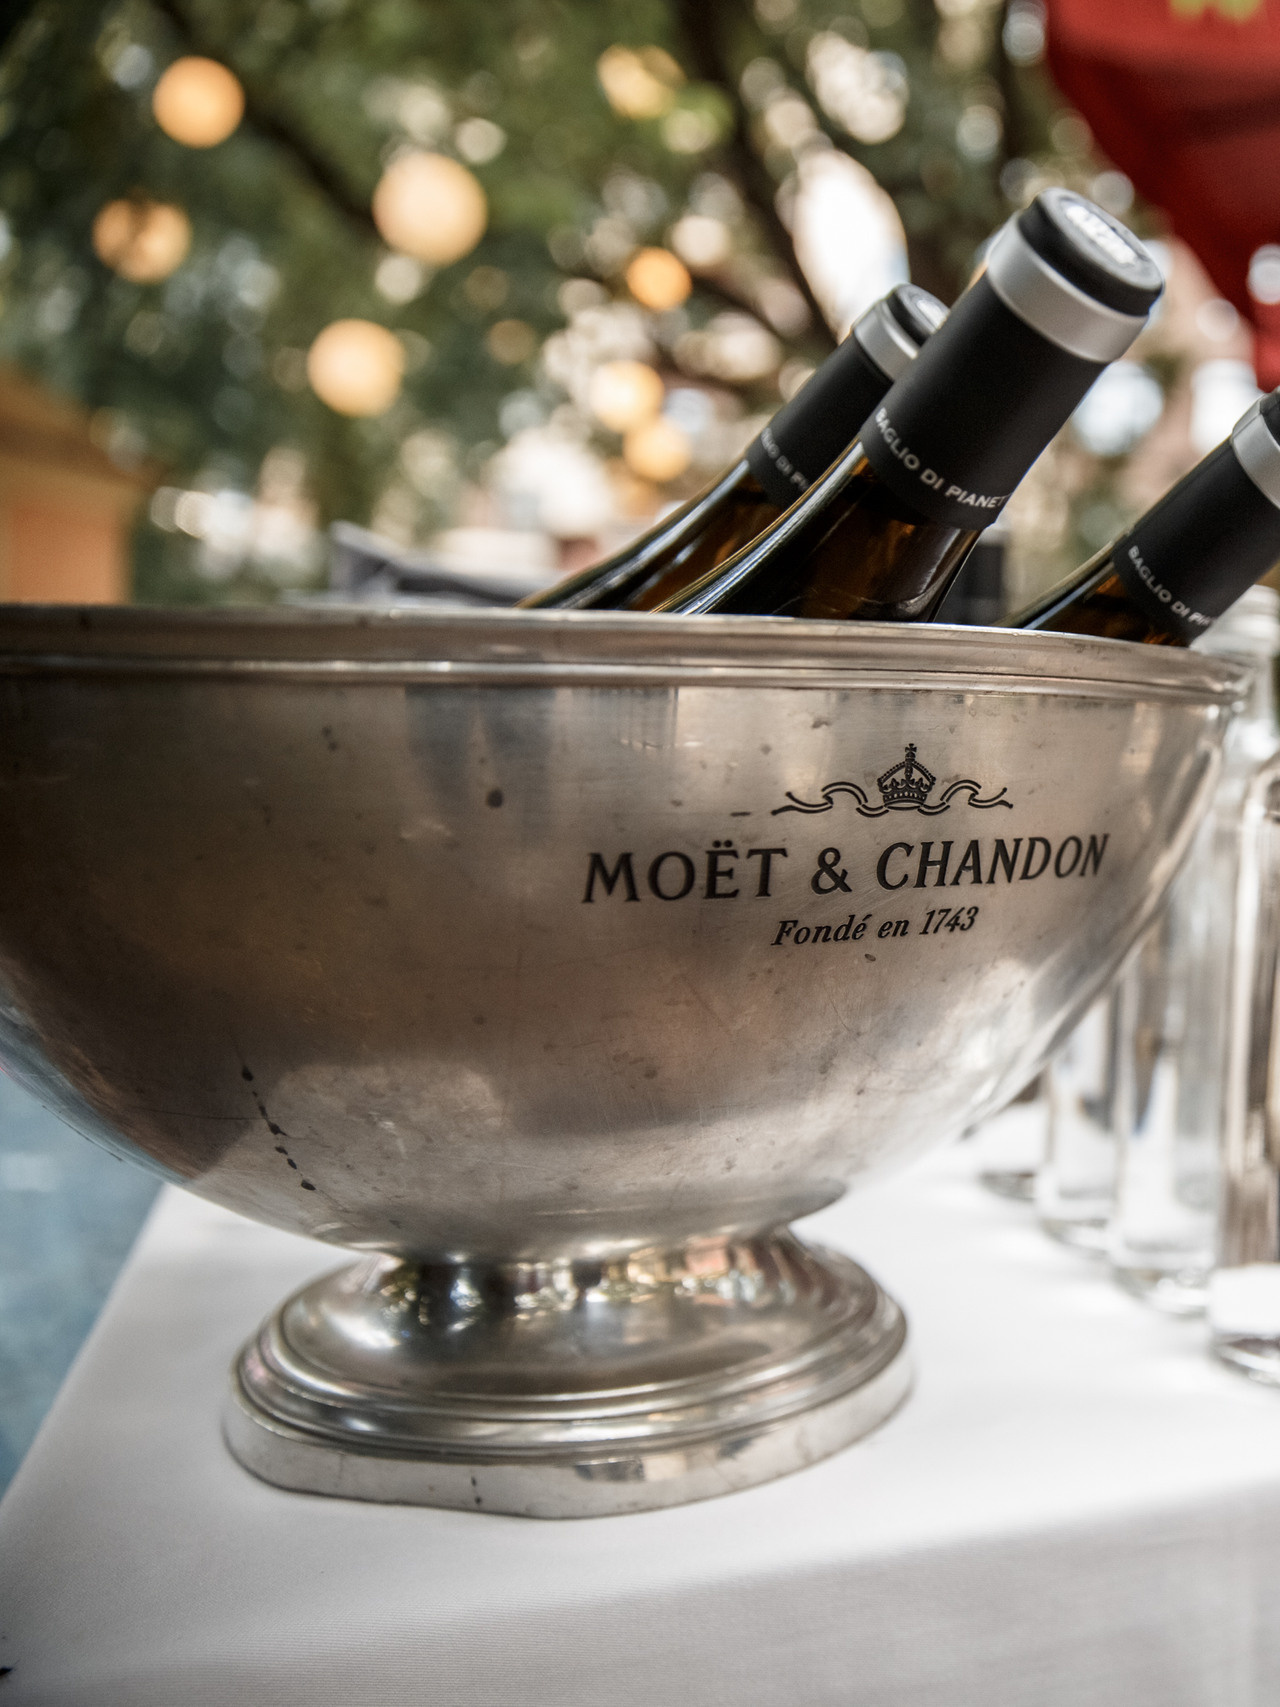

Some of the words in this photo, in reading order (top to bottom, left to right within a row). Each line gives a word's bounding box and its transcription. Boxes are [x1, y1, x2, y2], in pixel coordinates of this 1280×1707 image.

[875, 407, 920, 471] BAGLIO
[920, 468, 944, 490] DI
[945, 485, 1013, 509] PIANET
[1128, 546, 1172, 603] BAGLIO
[1171, 601, 1190, 617] DI
[582, 840, 788, 903] MOËT
[811, 846, 852, 895] &
[875, 833, 1109, 890] CHANDON
[771, 914, 872, 946] Fondé
[877, 917, 909, 939] en
[919, 906, 980, 935] 1743
